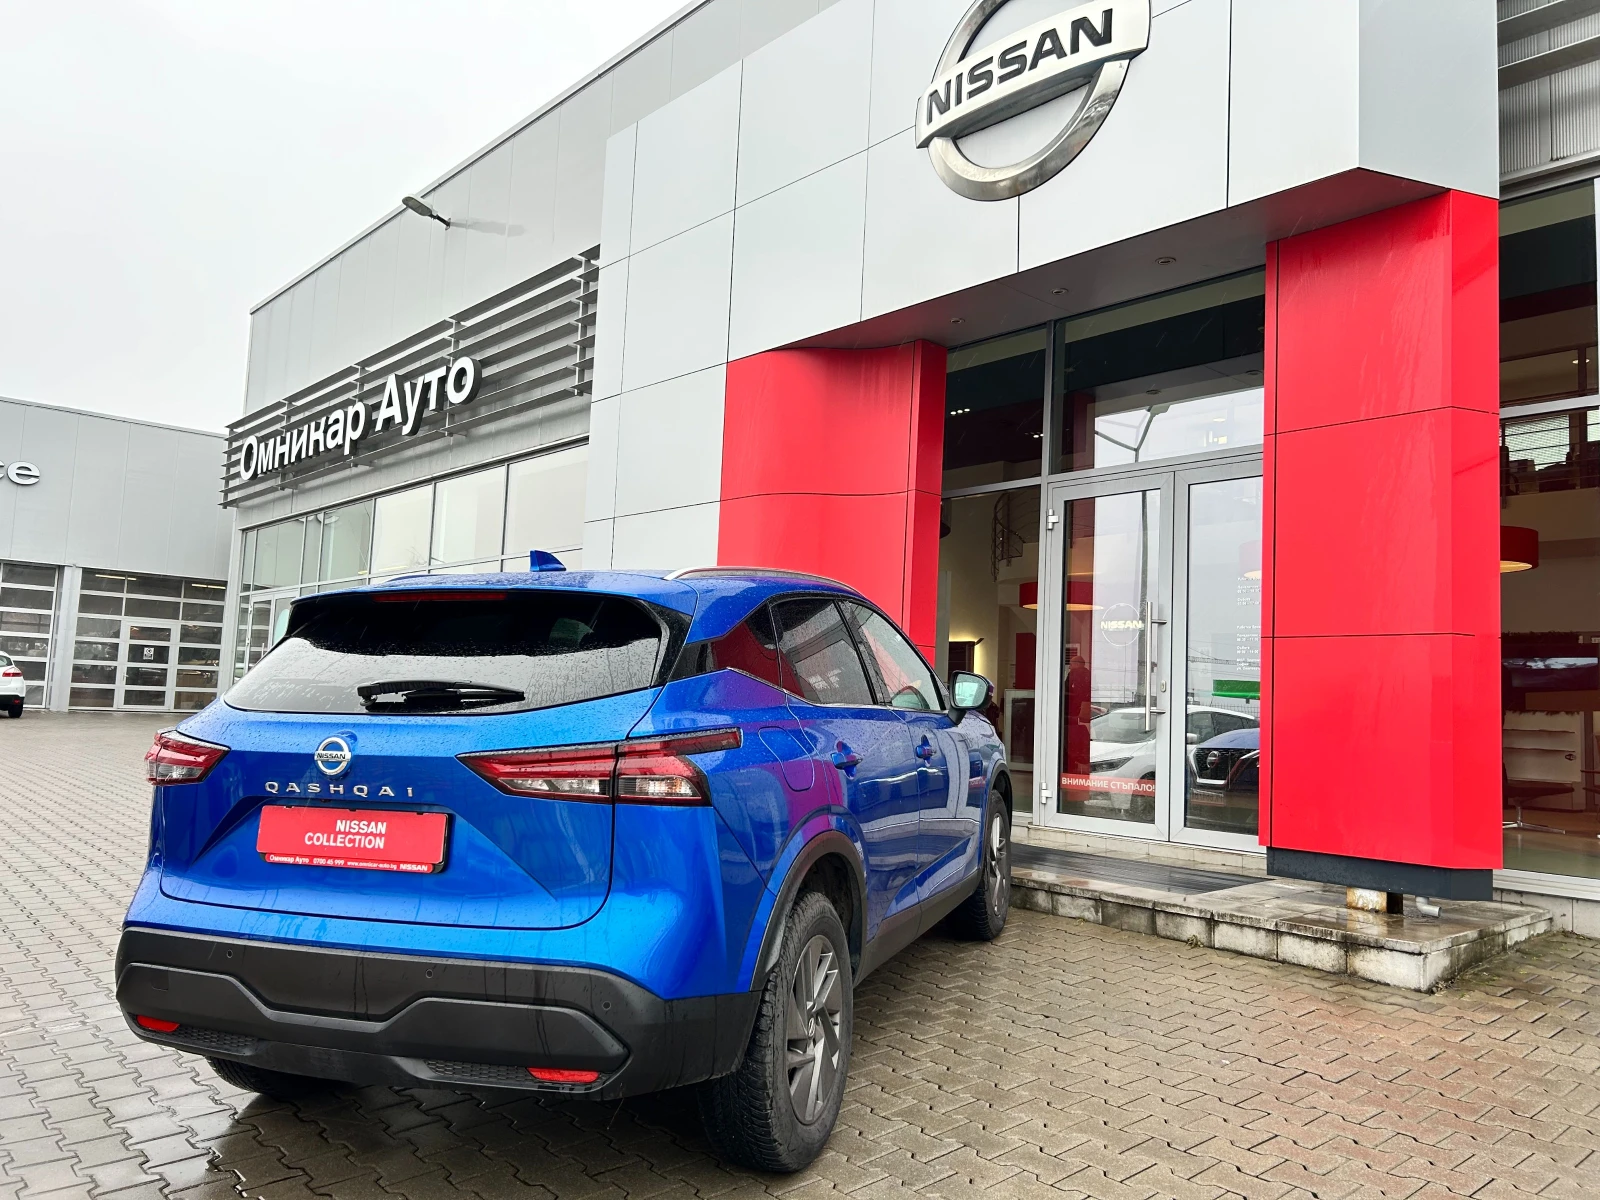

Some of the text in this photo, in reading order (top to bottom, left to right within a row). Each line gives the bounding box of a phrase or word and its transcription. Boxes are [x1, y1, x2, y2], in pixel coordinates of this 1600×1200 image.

[927, 8, 1113, 125] NISSAN
[240, 357, 479, 481] Омникар Ауто
[1100, 620, 1142, 630] NISSAN
[316, 752, 346, 760] NISSAN
[265, 781, 414, 798] QASHQAI
[1061, 777, 1155, 792] ВНИМАНИЕ СТЪПАЛО!
[336, 820, 387, 834] NISSAN
[304, 832, 385, 849] COLLECTION
[295, 856, 309, 864] Ауто
[400, 863, 428, 871] NISSAN
